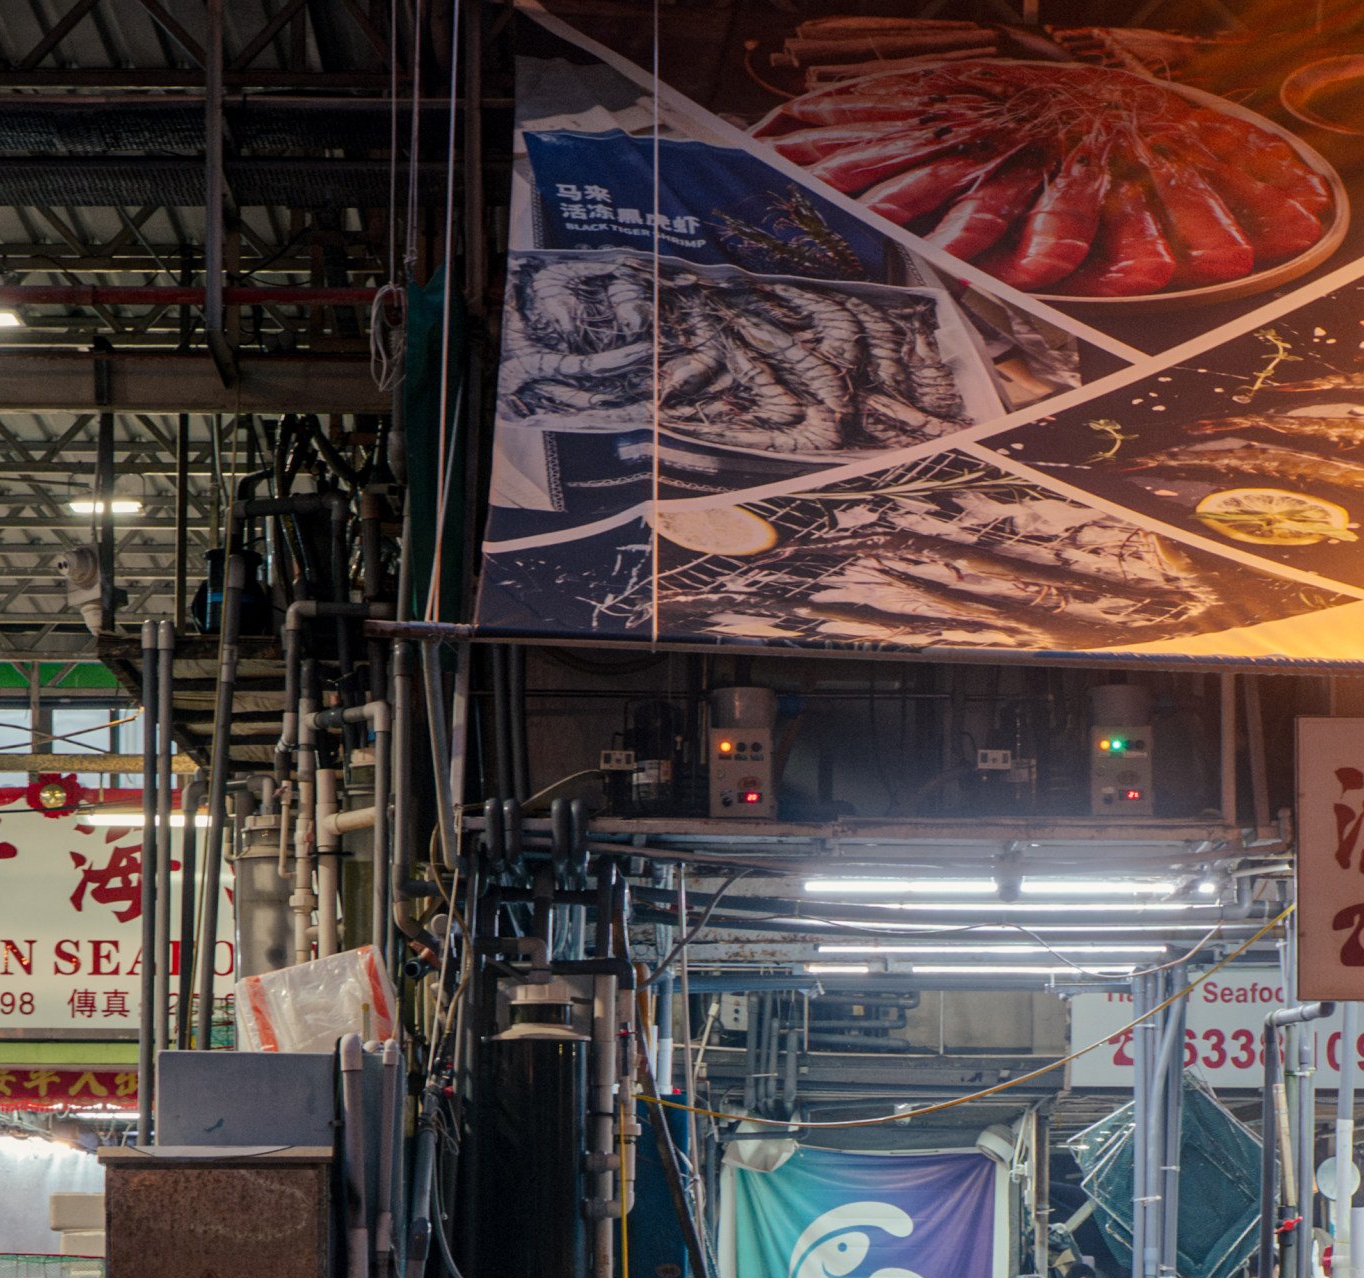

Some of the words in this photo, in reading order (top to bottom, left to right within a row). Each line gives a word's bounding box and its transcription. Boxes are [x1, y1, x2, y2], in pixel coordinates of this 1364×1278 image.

[555, 183, 613, 203] 马来
[565, 222, 608, 232] BLACK
[611, 224, 651, 237] TIGER
